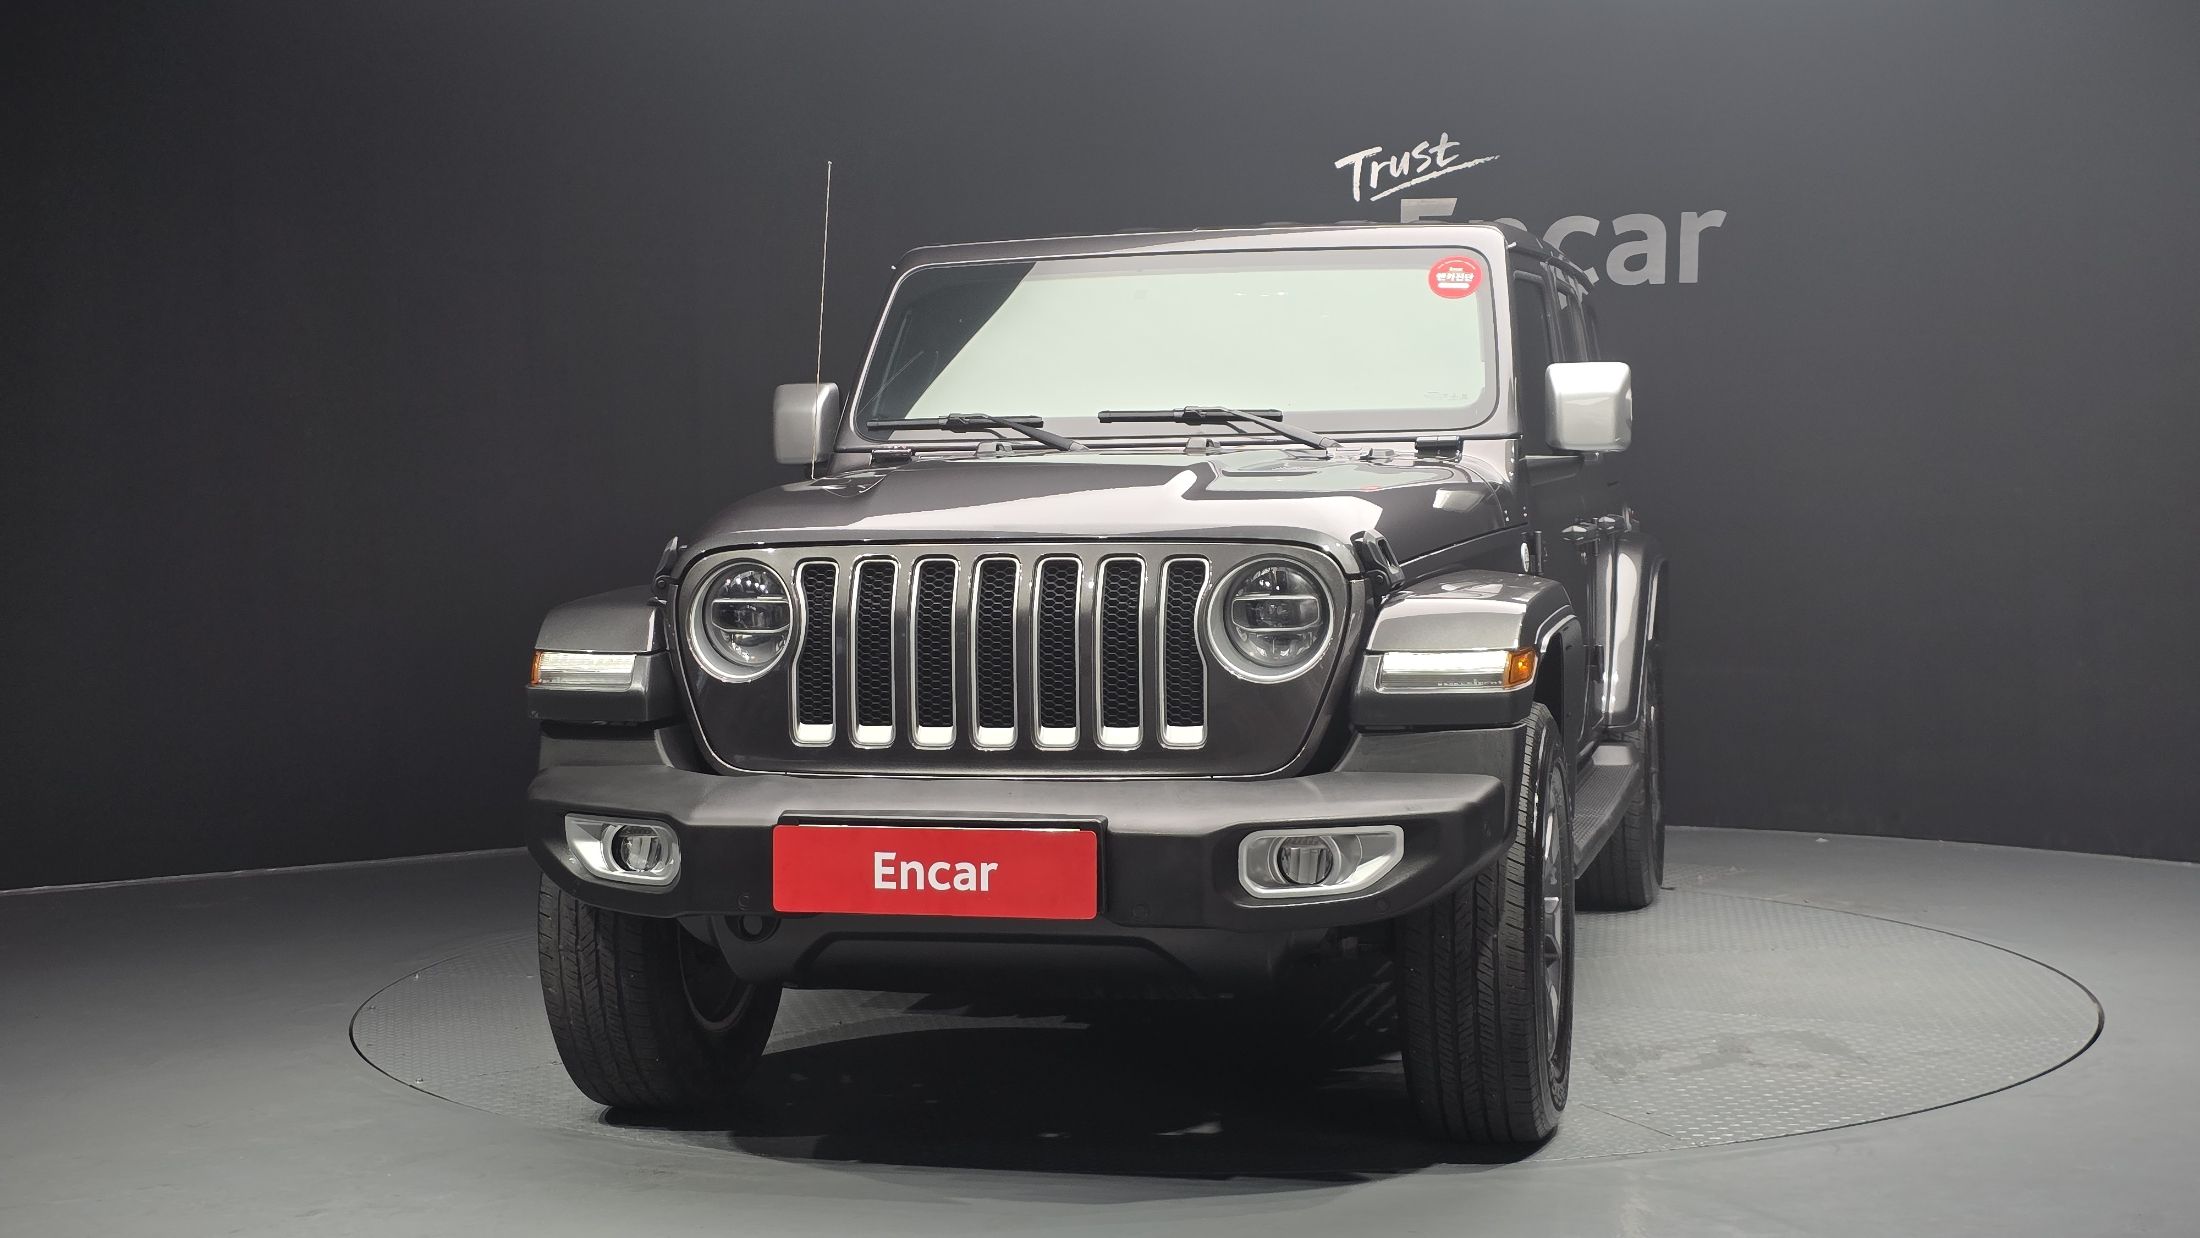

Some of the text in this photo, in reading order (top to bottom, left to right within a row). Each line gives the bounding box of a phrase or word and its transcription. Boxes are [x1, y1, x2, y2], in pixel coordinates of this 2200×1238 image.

[1335, 132, 1460, 201] Trust
[1400, 197, 1727, 286] car
[874, 851, 998, 892] Encar
